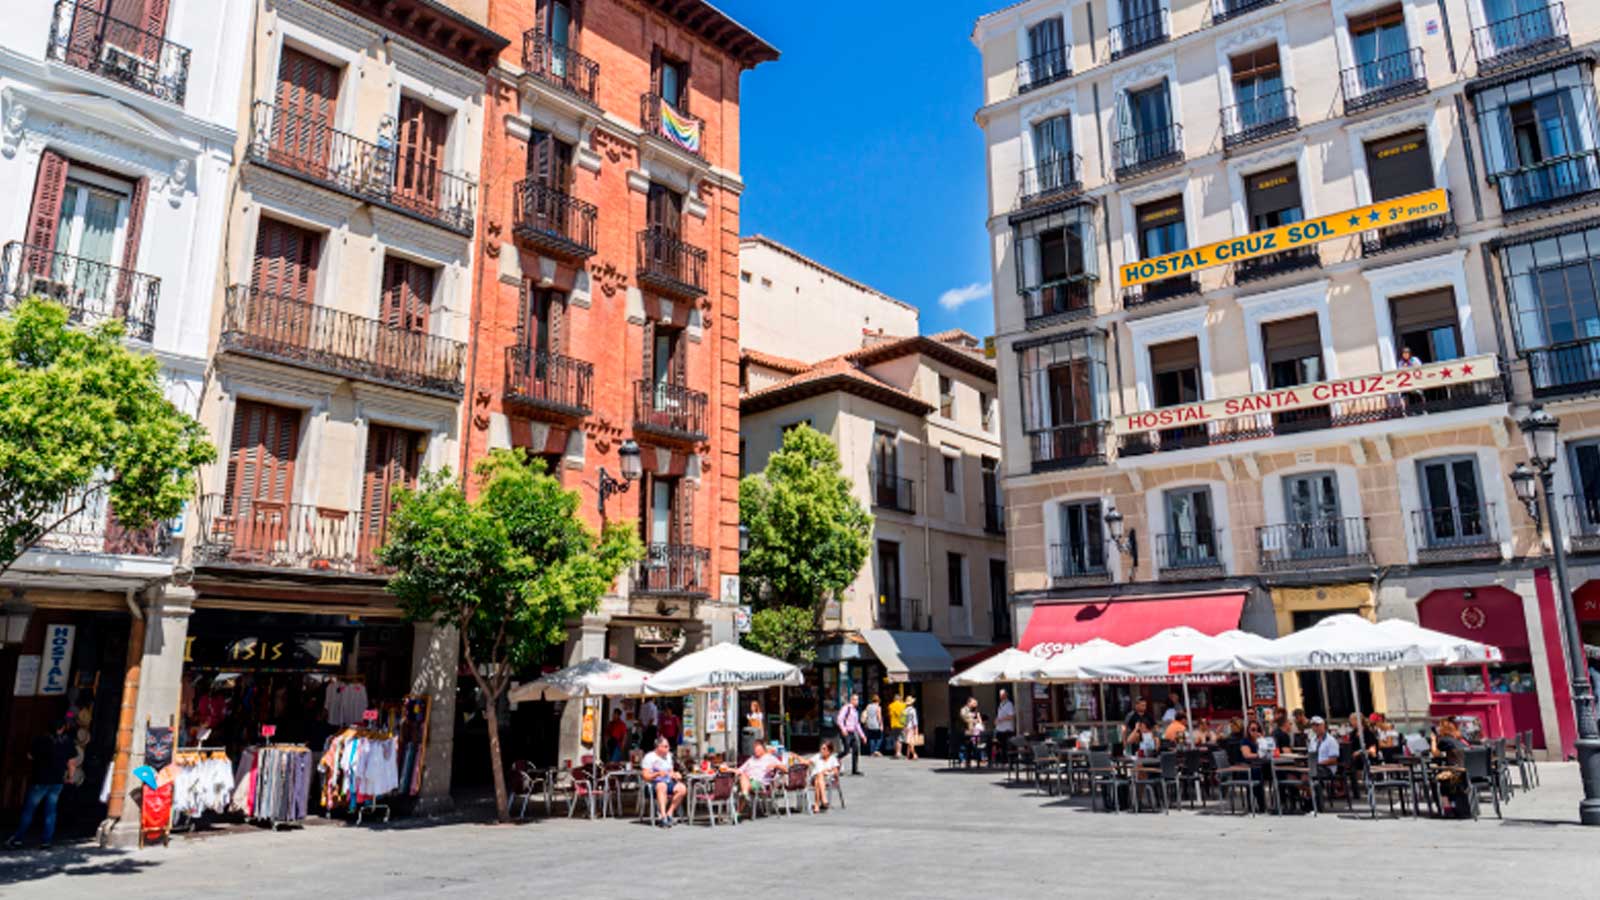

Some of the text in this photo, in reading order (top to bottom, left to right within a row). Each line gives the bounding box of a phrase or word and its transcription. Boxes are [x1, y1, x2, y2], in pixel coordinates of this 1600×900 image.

[1126, 252, 1208, 282] HOSTAL
[1215, 233, 1276, 259] CRUZ
[1288, 221, 1335, 243] SOL
[1408, 202, 1439, 216] PISO
[1128, 406, 1211, 430] HOSTAL
[1225, 390, 1299, 415] SANTA
[47, 627, 69, 686] HOSTAL
[232, 641, 284, 660] ISIS
